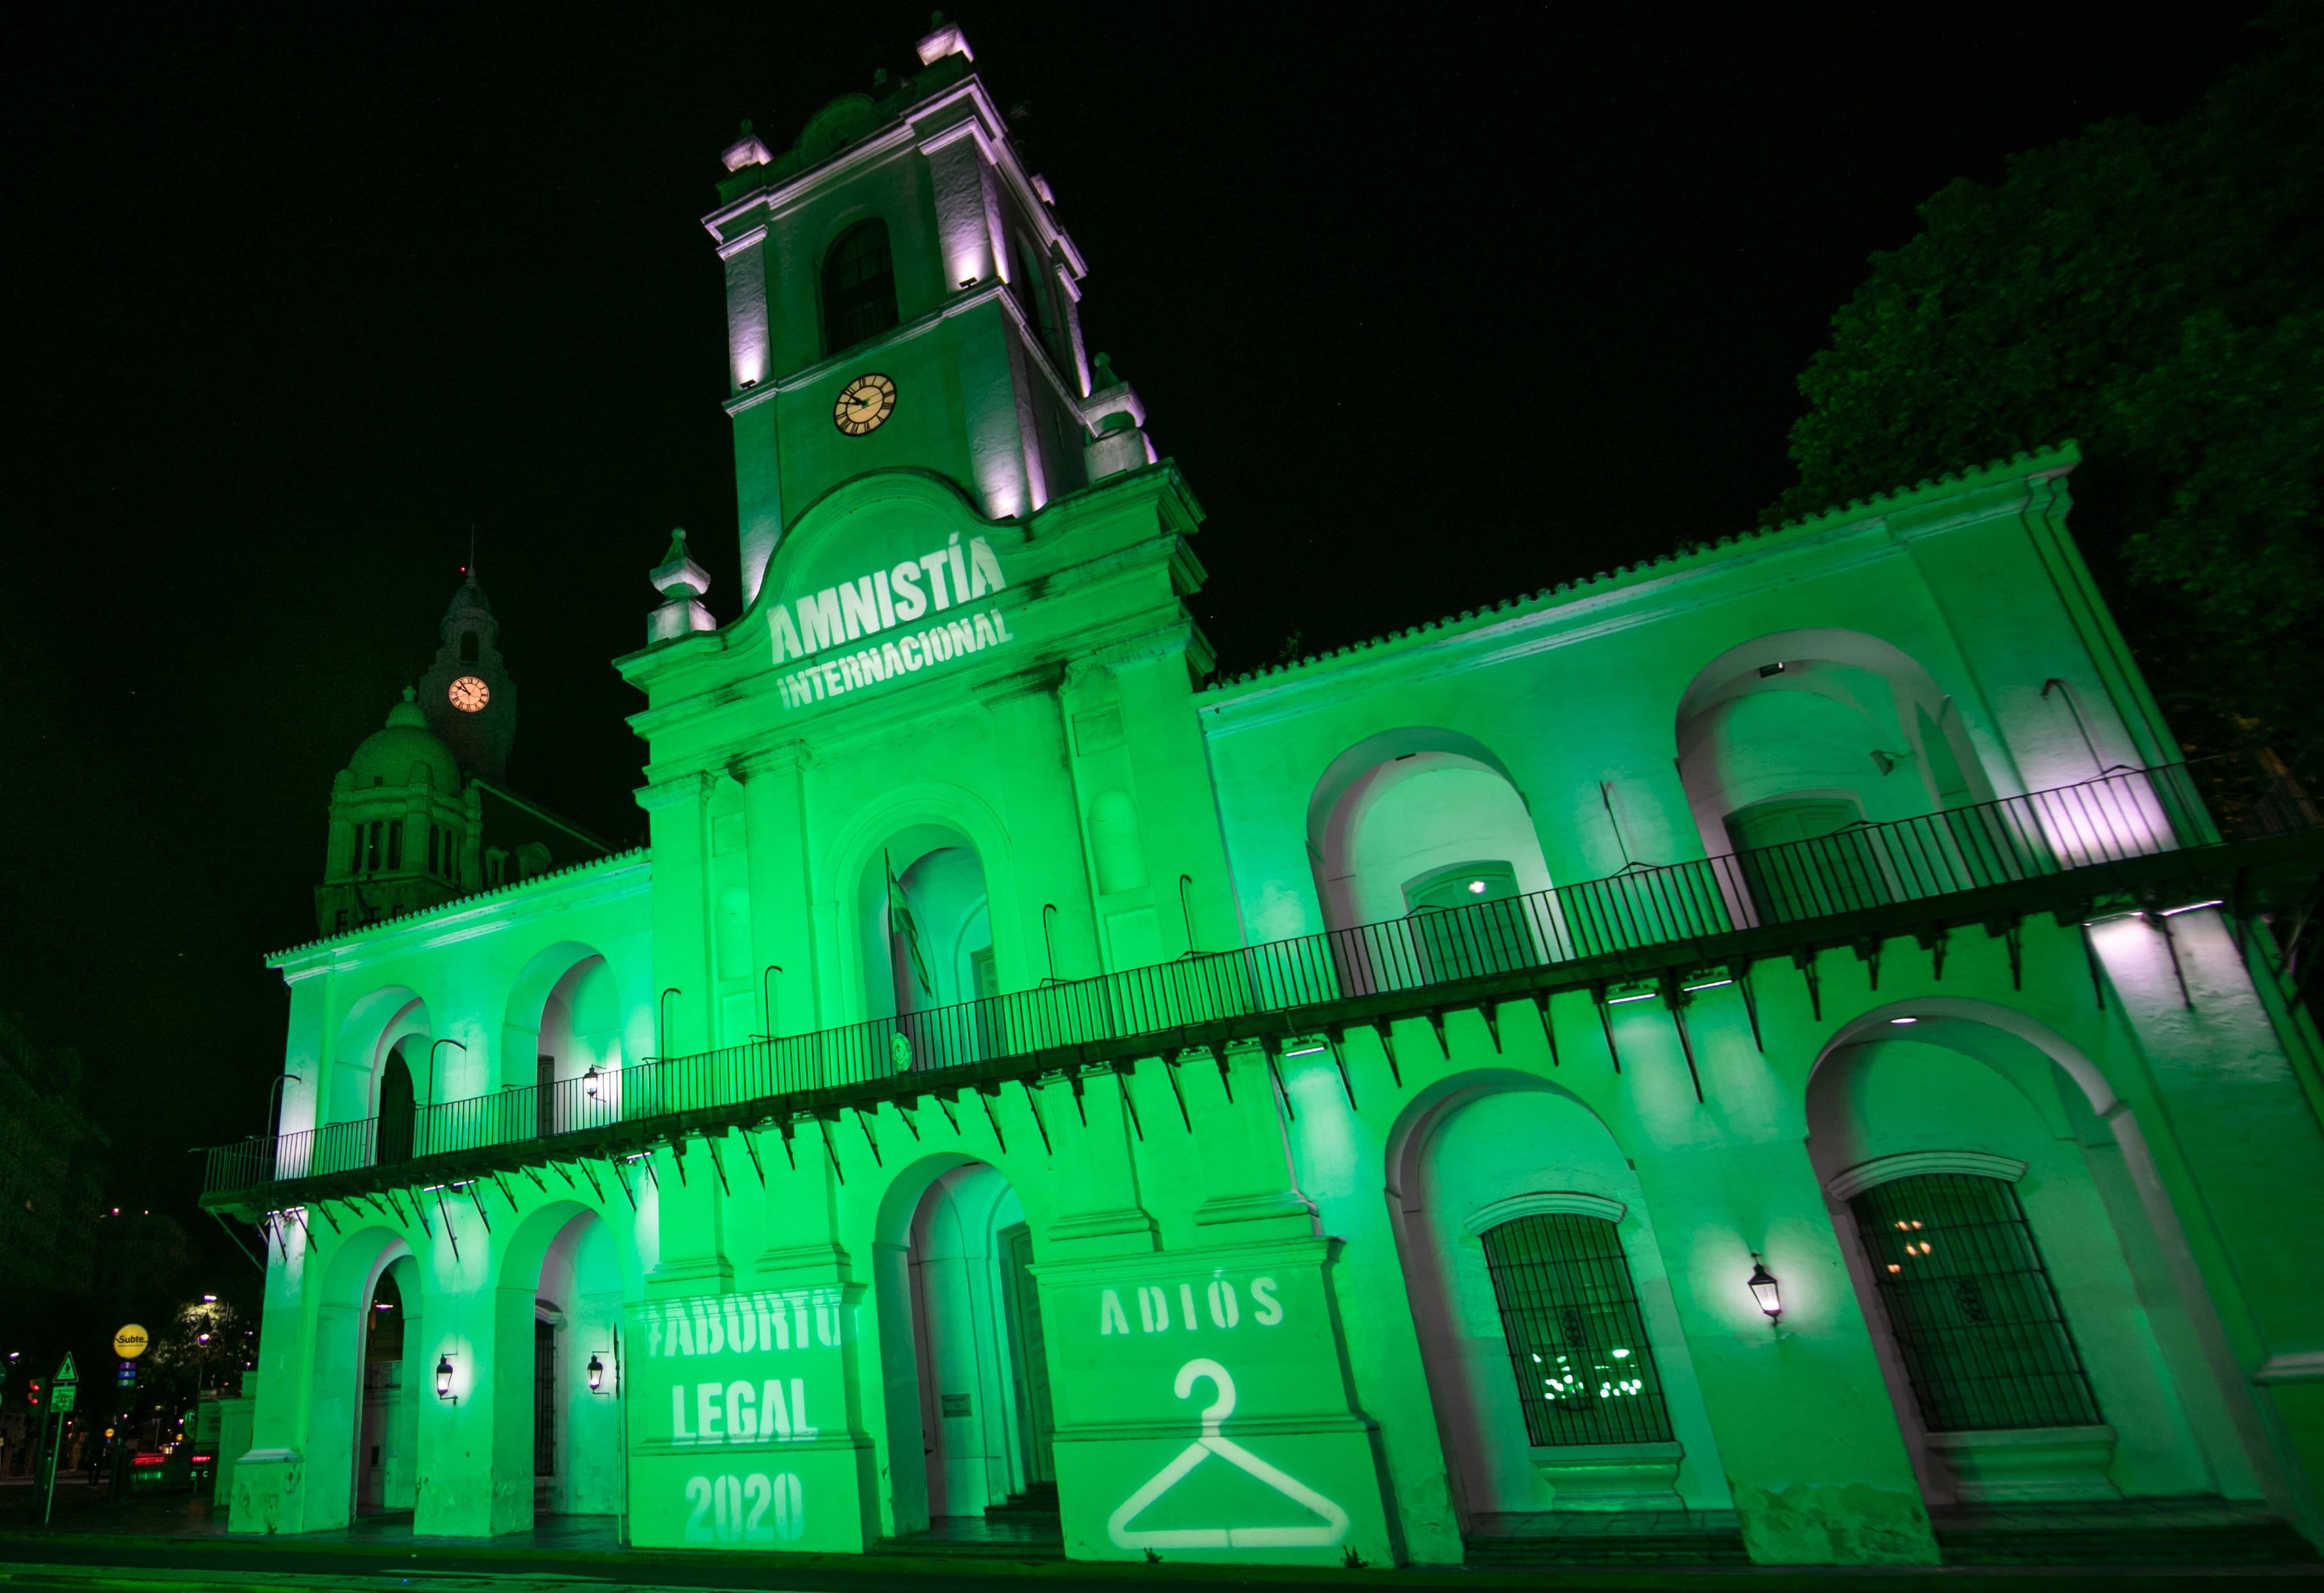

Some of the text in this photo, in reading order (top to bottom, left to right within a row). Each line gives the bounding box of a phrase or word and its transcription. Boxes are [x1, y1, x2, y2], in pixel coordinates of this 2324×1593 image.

[767, 531, 1007, 665] AMNISTÍA
[776, 609, 1014, 710] INTERNACIONAL
[1100, 1267, 1283, 1335] ADIÓS
[119, 1335, 144, 1343] Subte
[672, 1378, 818, 1446] LEGAL
[684, 1473, 804, 1542] 2020
